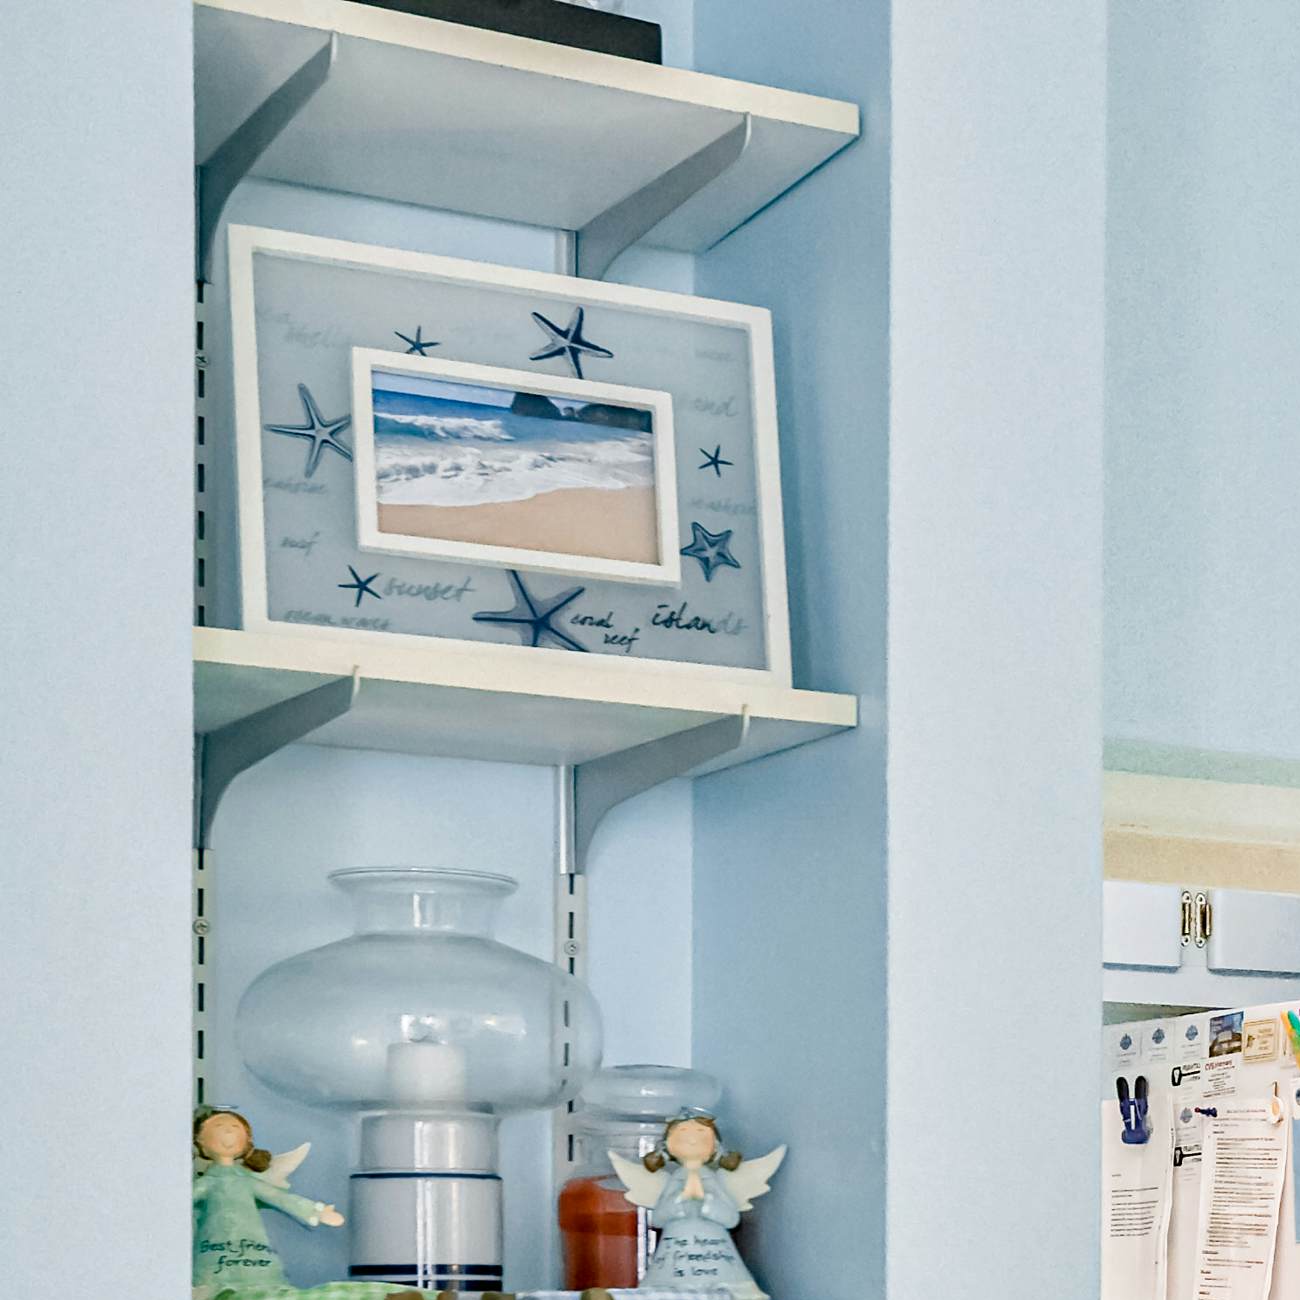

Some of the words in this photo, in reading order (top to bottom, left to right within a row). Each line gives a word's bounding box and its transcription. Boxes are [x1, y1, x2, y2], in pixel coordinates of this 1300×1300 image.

[383, 576, 476, 602] sunset
[603, 627, 641, 653] reef
[213, 1255, 272, 1274] forever
[691, 1266, 719, 1277] love
